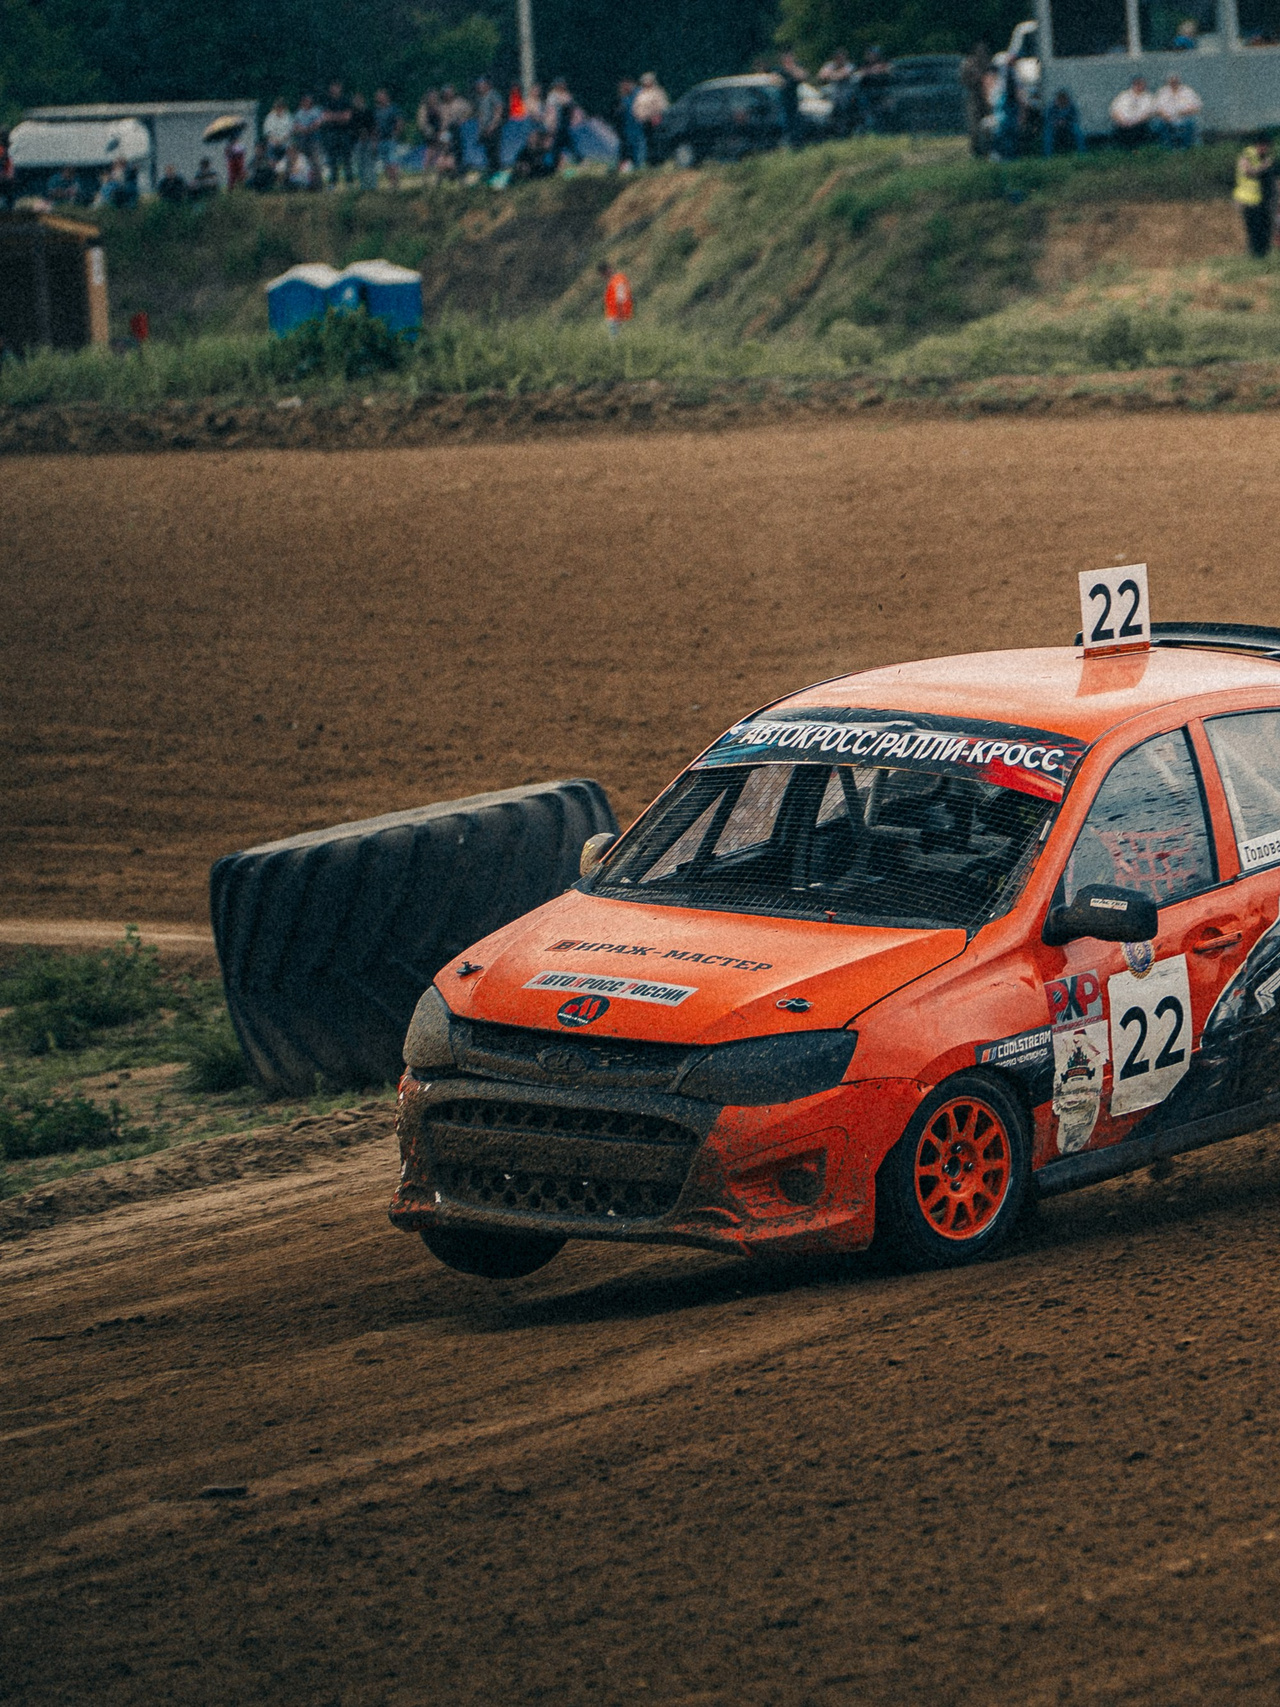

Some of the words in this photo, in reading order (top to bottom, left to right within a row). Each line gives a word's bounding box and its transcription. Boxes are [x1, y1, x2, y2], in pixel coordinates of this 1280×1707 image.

[1088, 578, 1143, 642] 22
[533, 974, 626, 993] АВТОКРОСС
[621, 982, 690, 1002] РОССИИ
[998, 1029, 1052, 1059] COOLSTREAM
[1119, 995, 1186, 1082] 22
